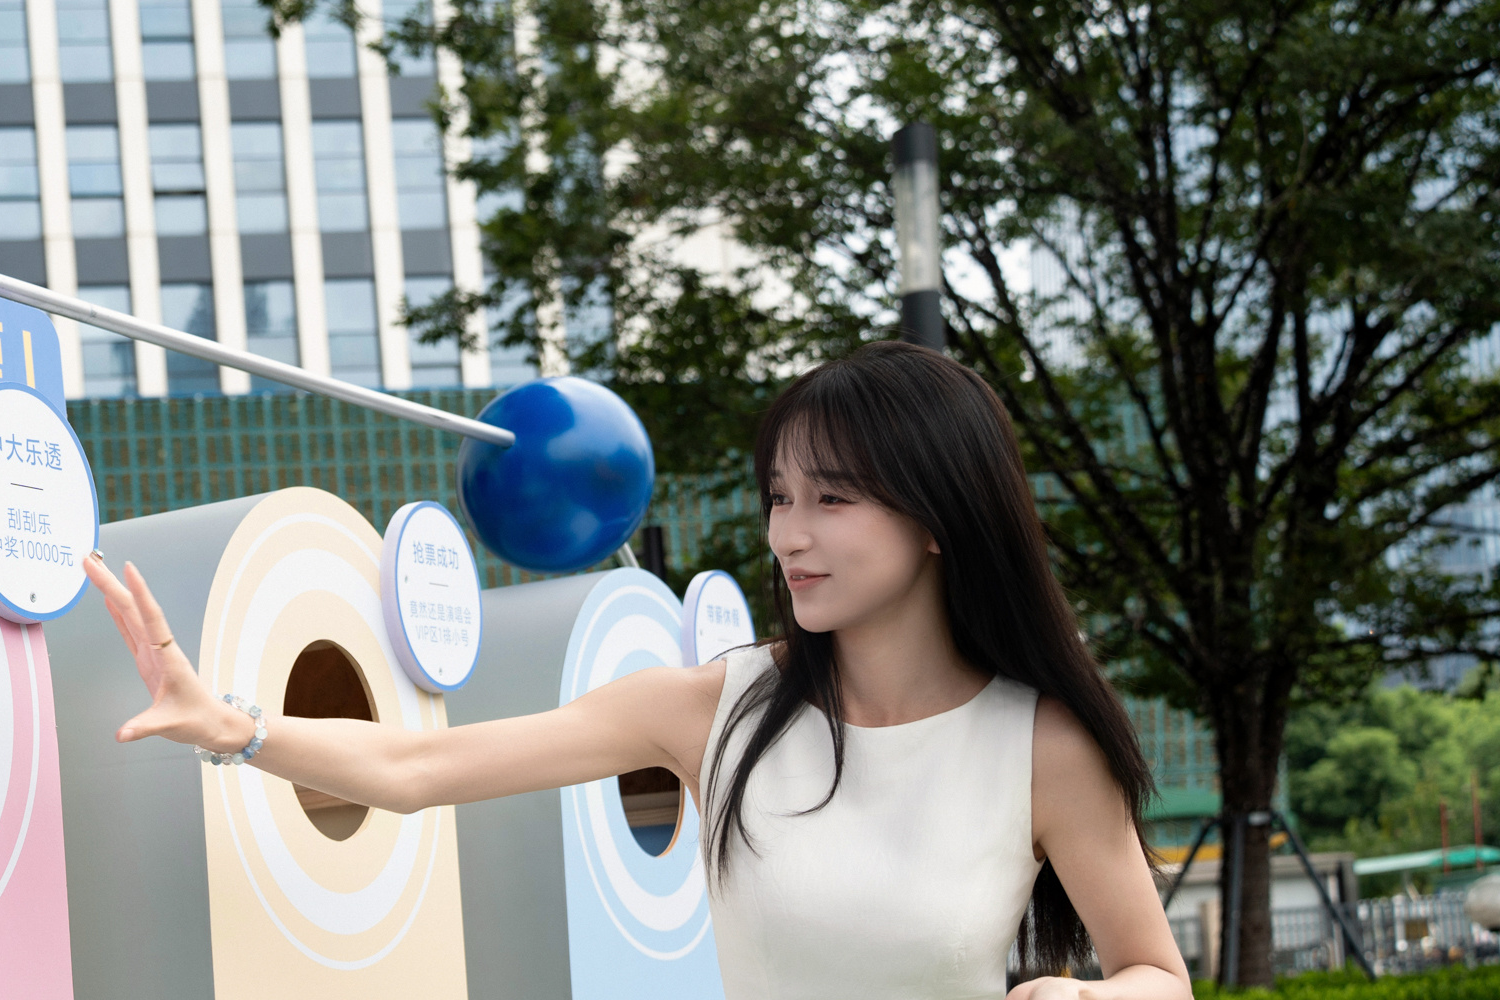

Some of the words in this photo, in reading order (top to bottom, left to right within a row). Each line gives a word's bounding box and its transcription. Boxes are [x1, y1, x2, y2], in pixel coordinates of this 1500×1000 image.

[7, 508, 52, 535] 刮刮乐
[412, 540, 459, 570] 抢票成功
